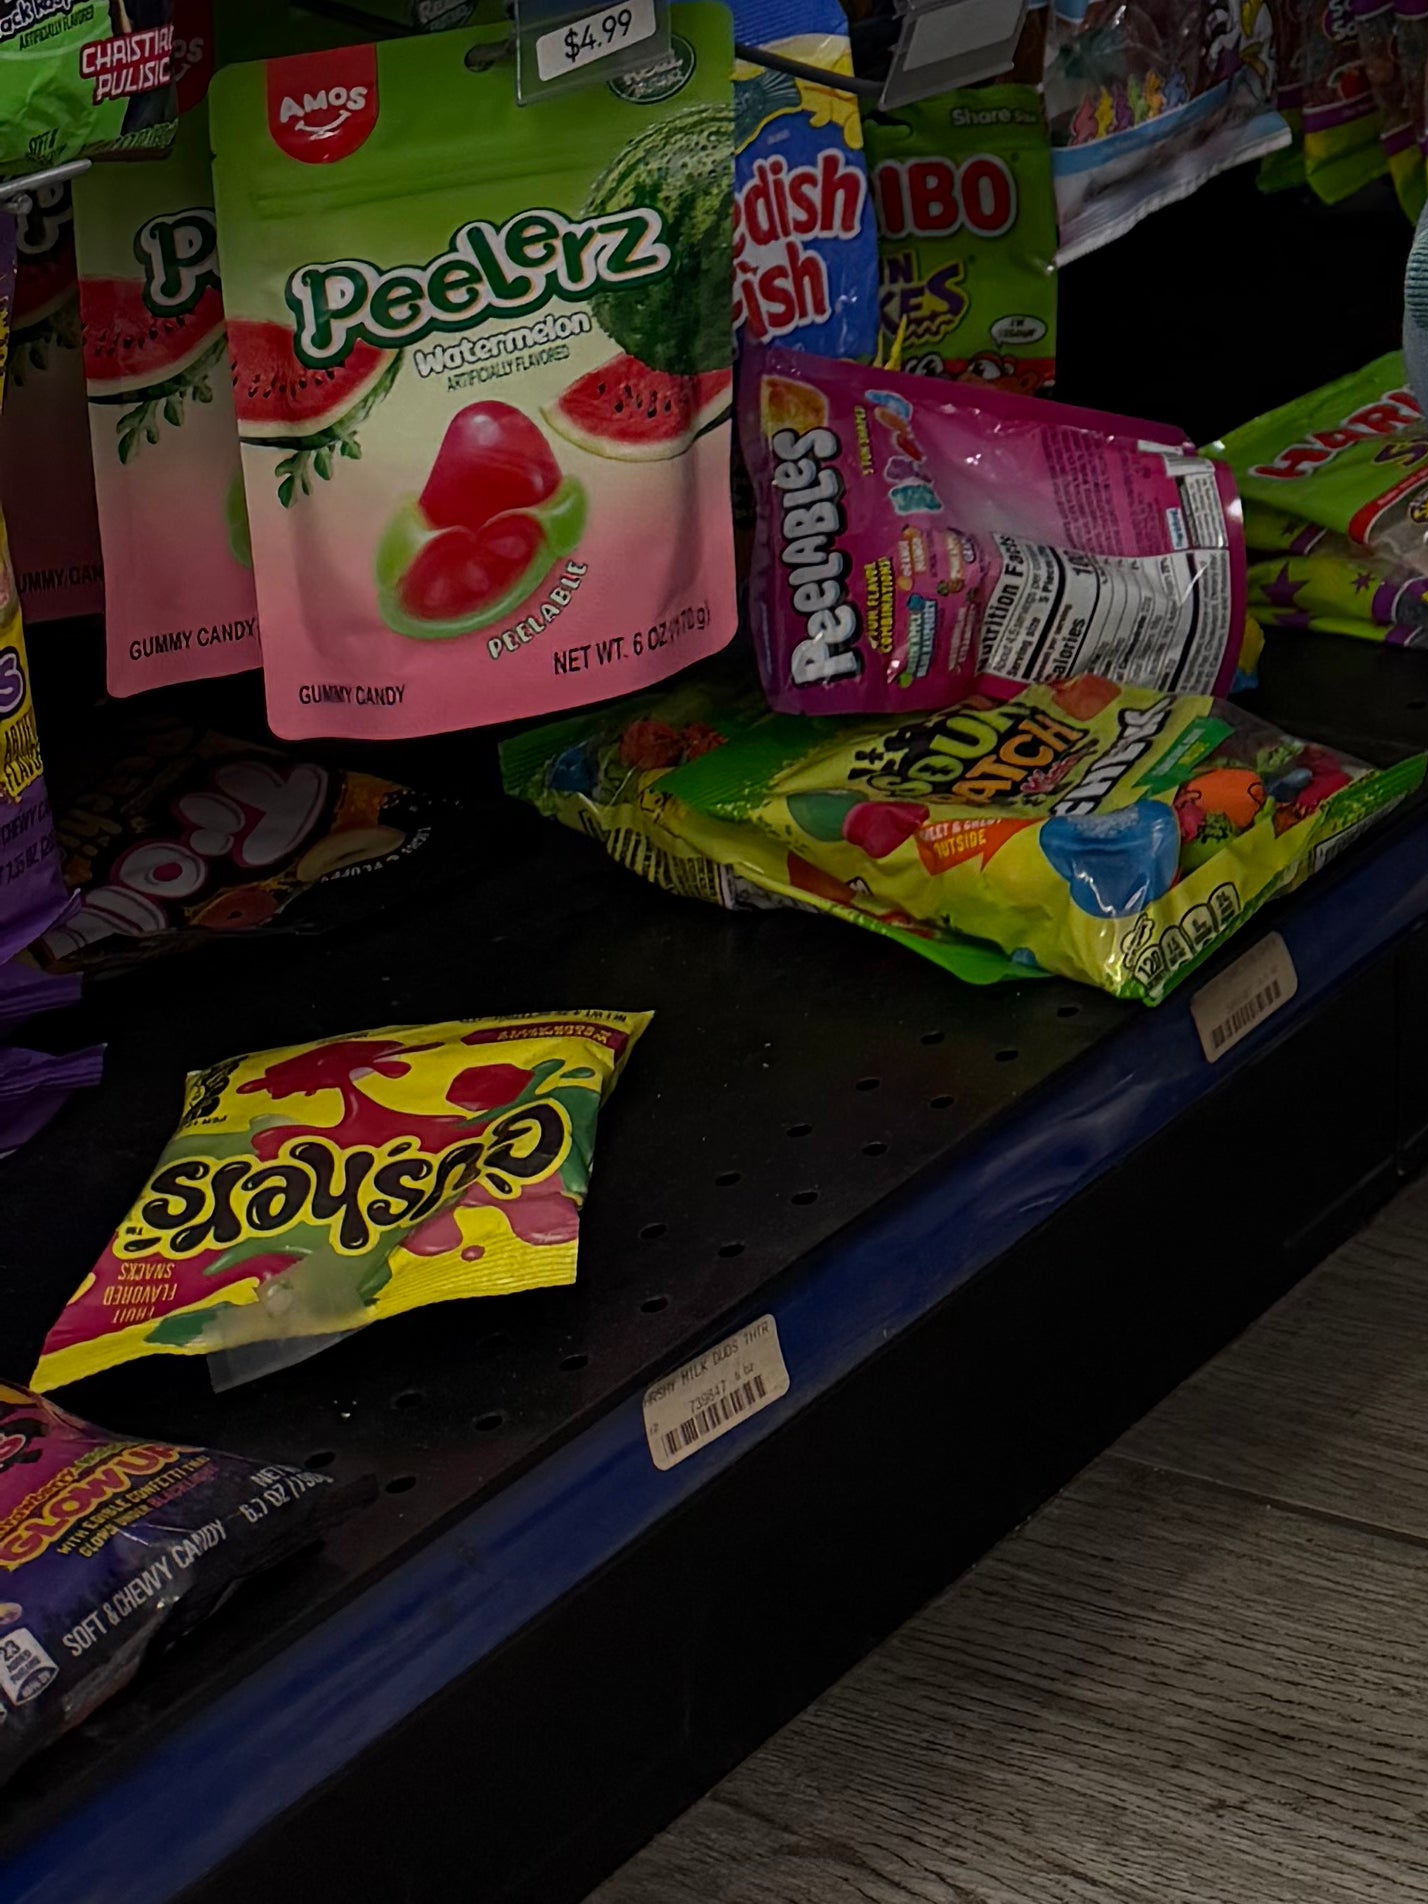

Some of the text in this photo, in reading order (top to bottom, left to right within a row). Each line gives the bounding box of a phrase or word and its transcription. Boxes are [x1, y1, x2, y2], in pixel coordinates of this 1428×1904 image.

[81, 26, 174, 76] CHRISTIA
[562, 10, 635, 61] $4.99
[279, 84, 368, 124] AMOS
[950, 105, 1010, 129] Share
[282, 206, 671, 370] Peelerz
[413, 308, 593, 381] Watermelon
[486, 558, 589, 662] PEELABLE
[129, 616, 257, 661] GUMMY CANDY
[552, 648, 593, 677] NET
[596, 635, 629, 667] WT.
[632, 631, 644, 658] 6
[299, 683, 406, 707] GUMMY CANDY
[115, 1103, 571, 1255] Gushers
[117, 1261, 173, 1281] SNACKS
[103, 1284, 178, 1308] FLAVORED
[111, 1307, 154, 1325] FRUIT
[62, 1518, 228, 1658] SOFT & CHEWY CANDY
